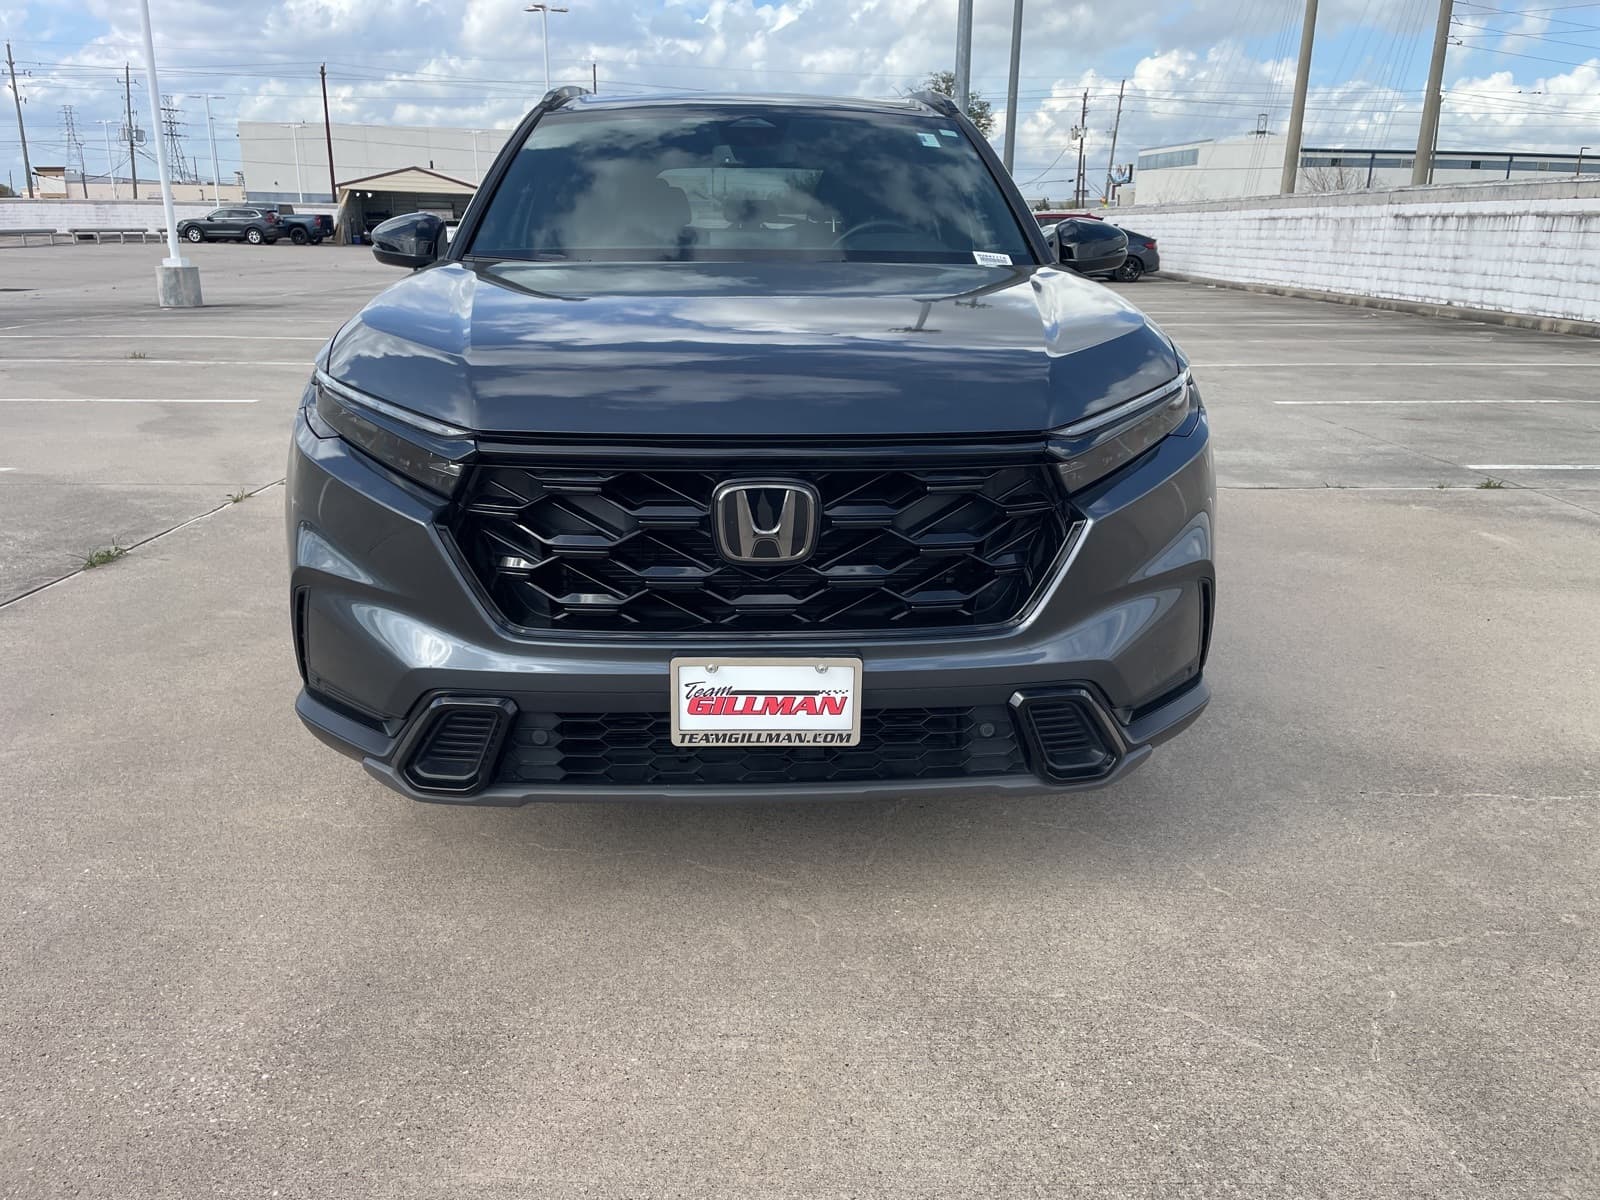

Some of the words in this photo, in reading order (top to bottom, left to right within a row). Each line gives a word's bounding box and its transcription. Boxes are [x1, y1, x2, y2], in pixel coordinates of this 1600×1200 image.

[684, 681, 733, 699] Team
[687, 696, 848, 716] GILLMAN
[679, 733, 852, 744] TEAMGILLMAN.COM
